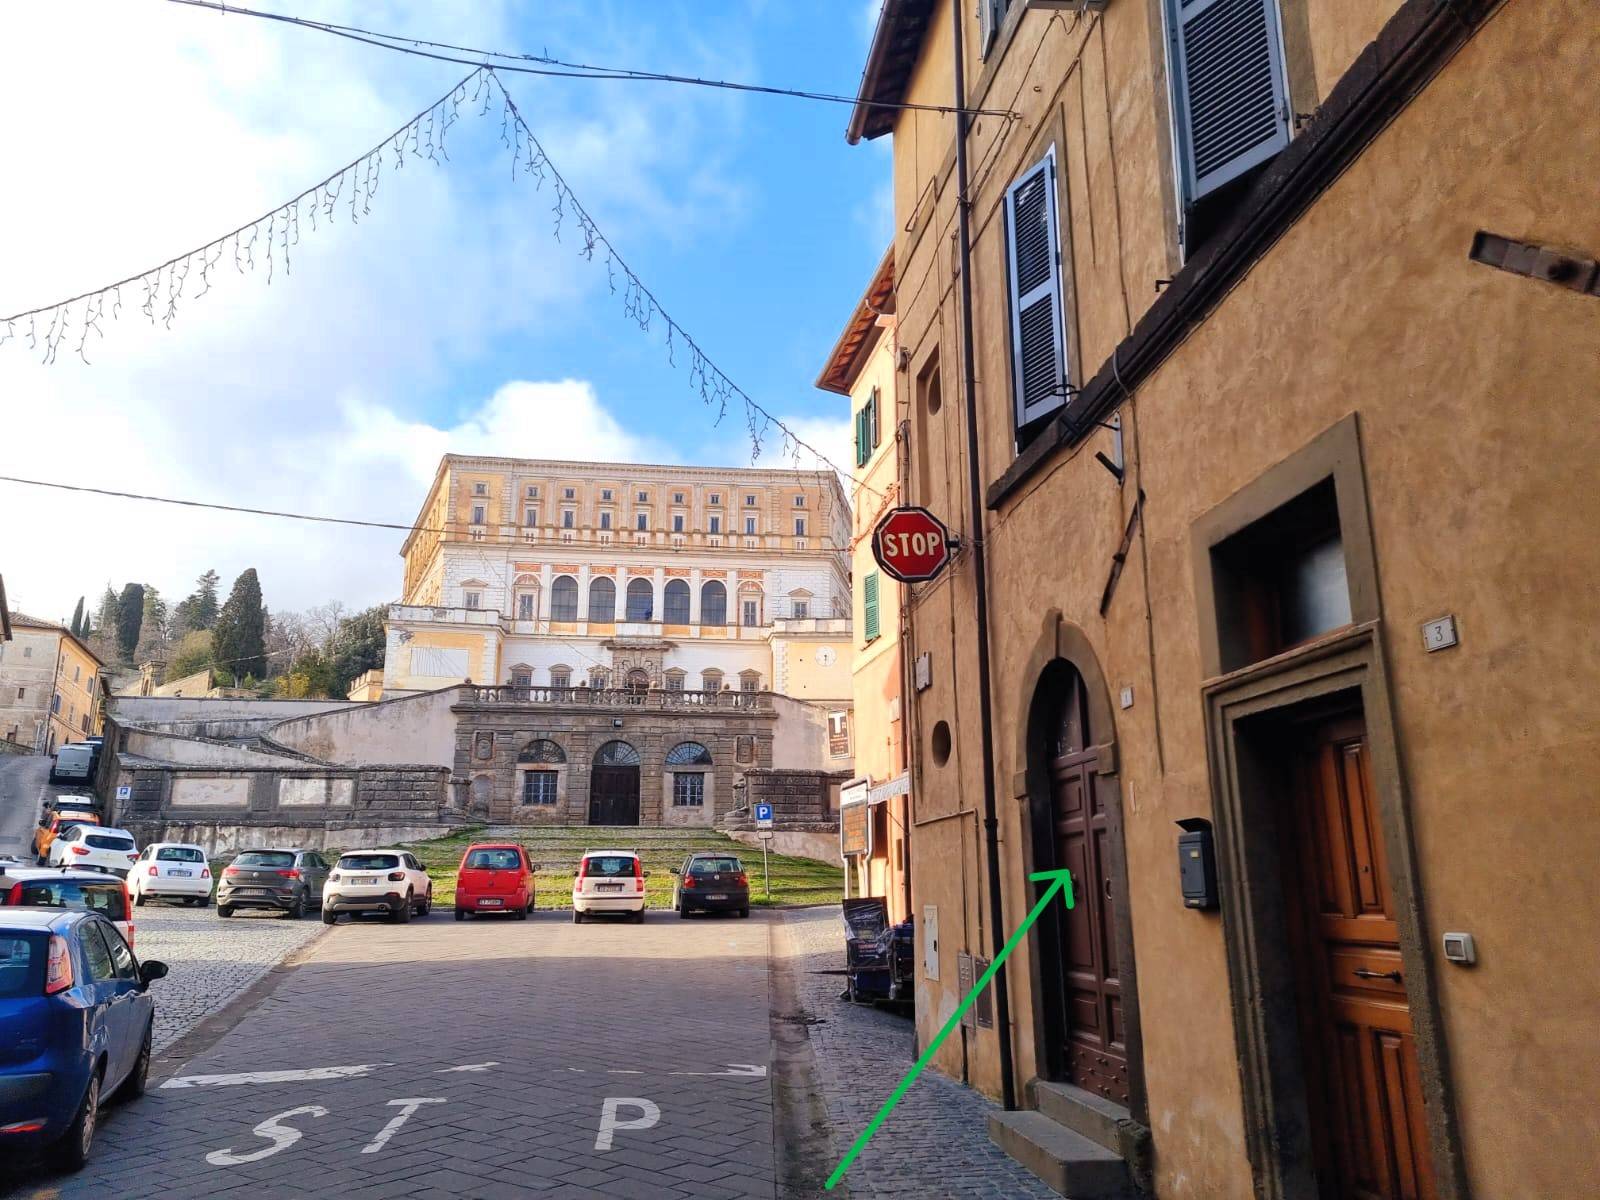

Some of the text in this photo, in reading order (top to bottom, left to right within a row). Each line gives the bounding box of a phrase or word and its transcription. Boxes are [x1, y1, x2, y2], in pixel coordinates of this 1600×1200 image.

[884, 532, 940, 557] STOP
[1434, 625, 1443, 642] 3
[759, 806, 769, 819] P
